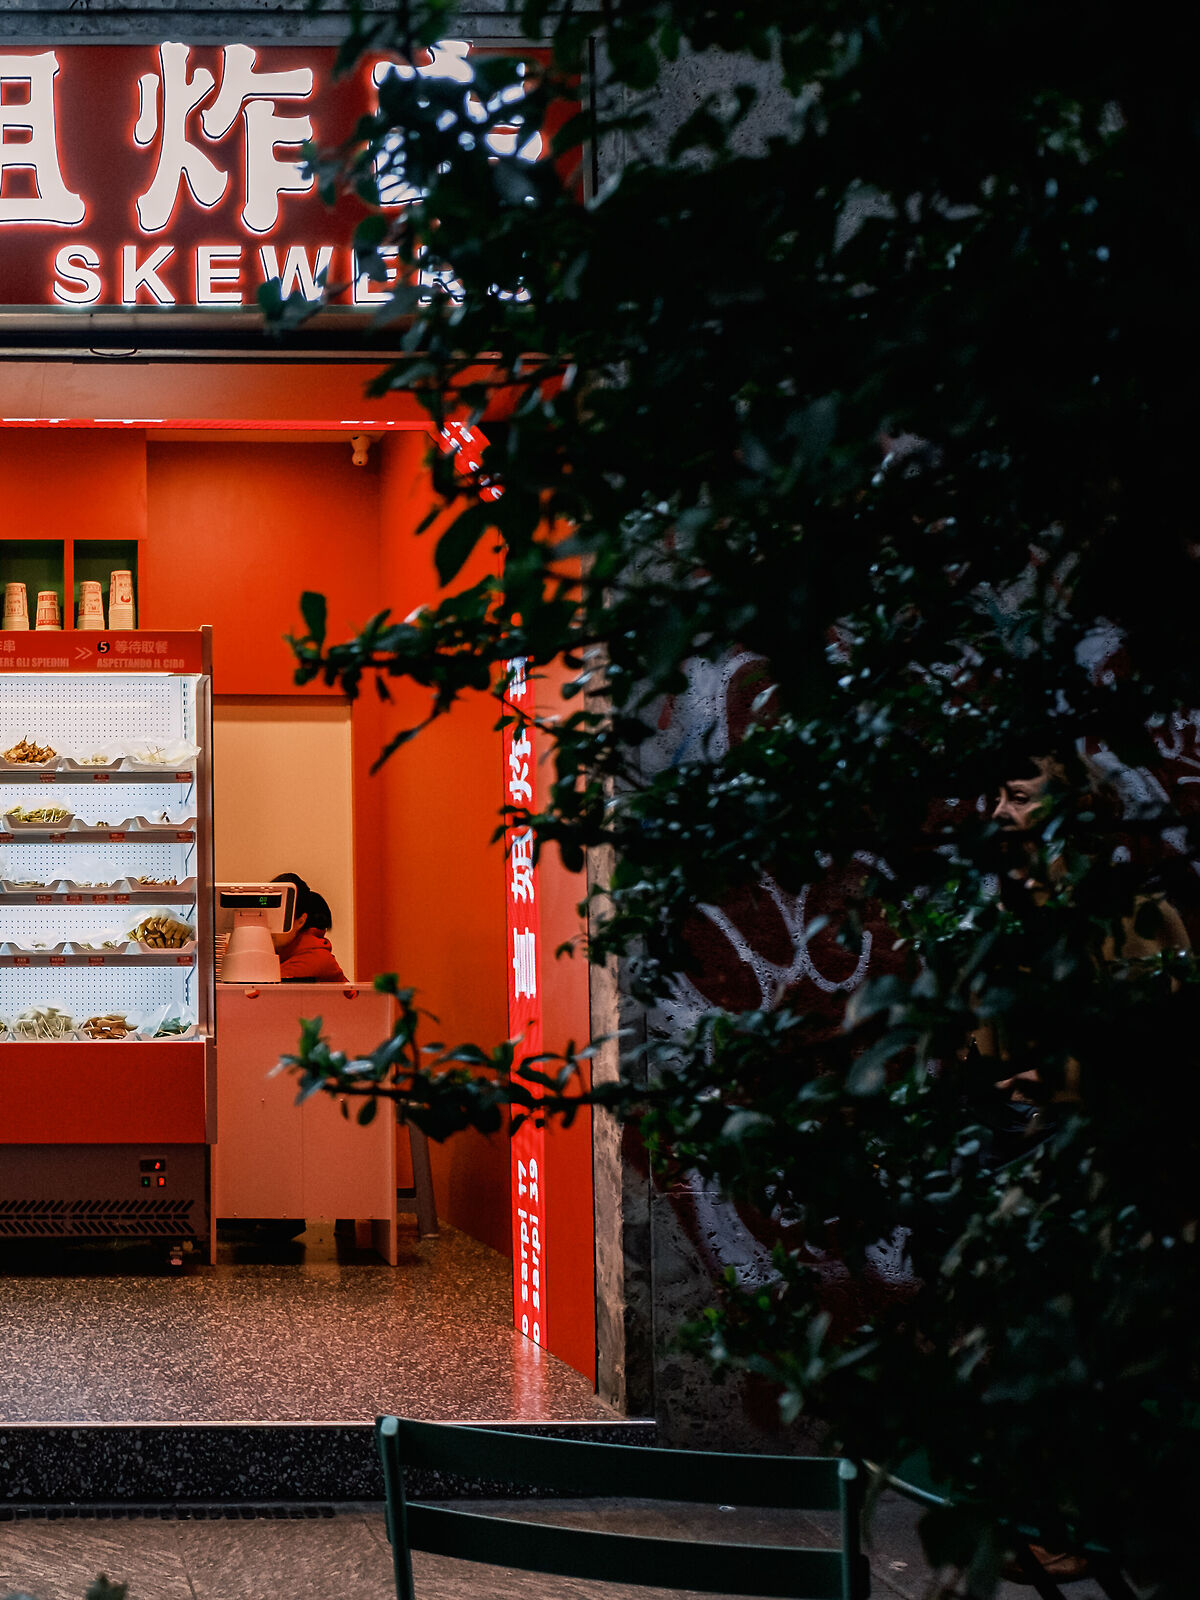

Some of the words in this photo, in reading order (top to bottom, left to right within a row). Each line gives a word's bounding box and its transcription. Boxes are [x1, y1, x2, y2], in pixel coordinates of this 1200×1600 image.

[98, 641, 109, 653] 5
[15, 657, 30, 668] GLI
[518, 1158, 528, 1198] 17
[530, 1157, 539, 1204] 39
